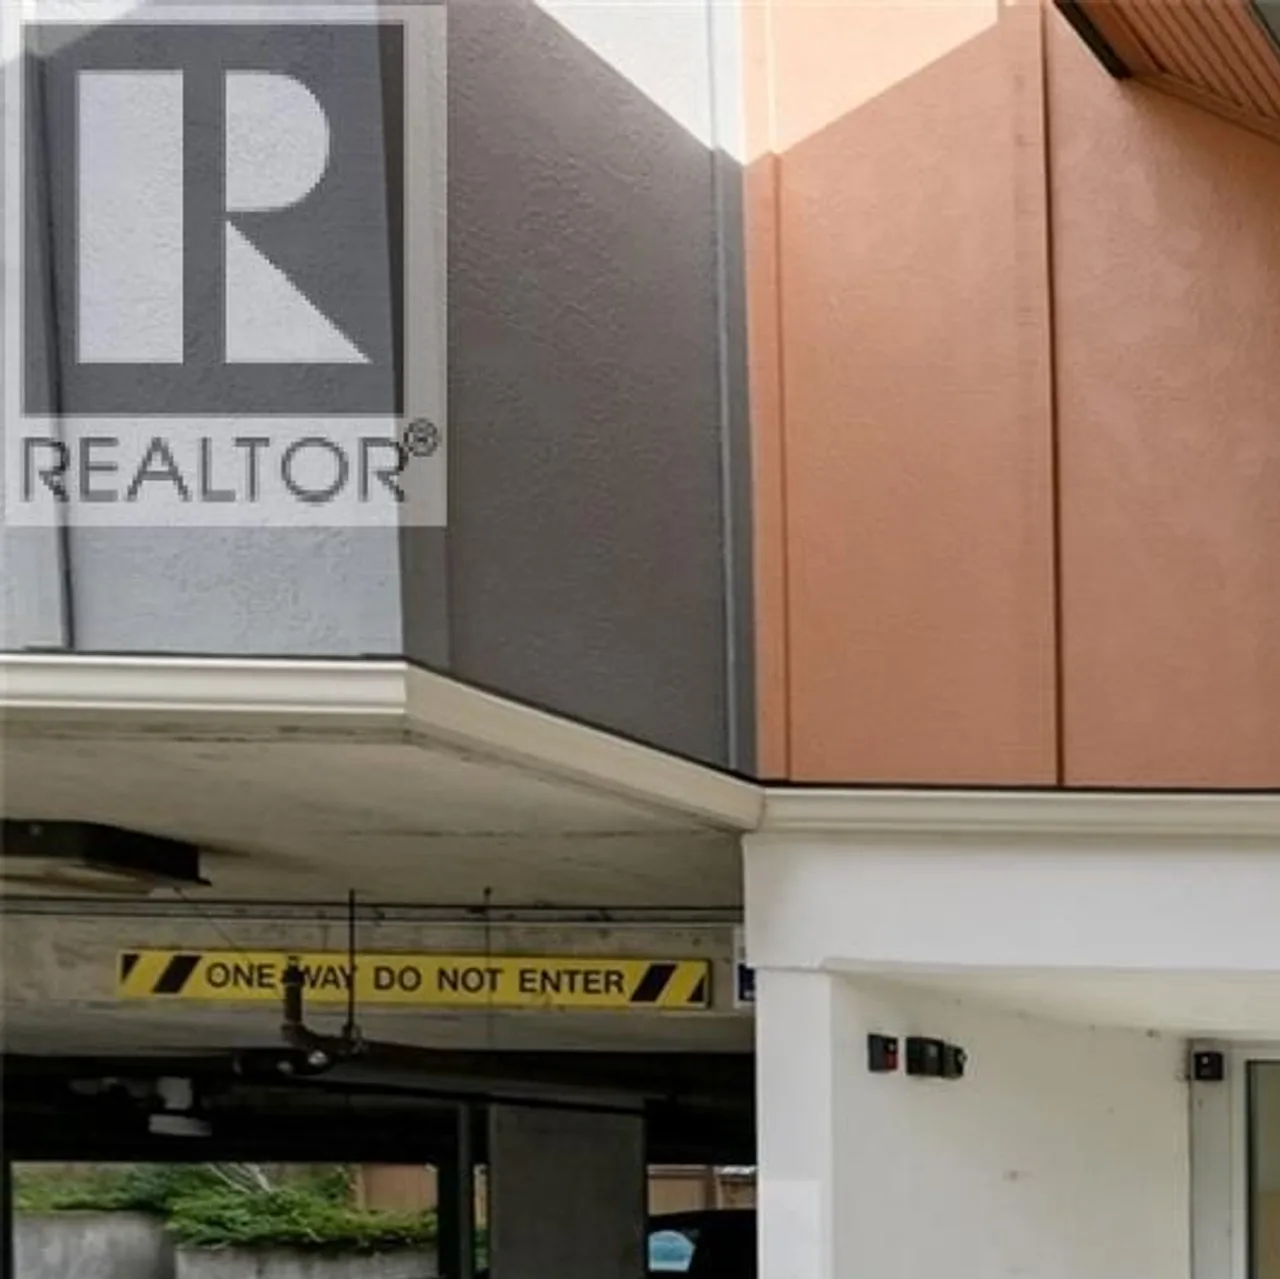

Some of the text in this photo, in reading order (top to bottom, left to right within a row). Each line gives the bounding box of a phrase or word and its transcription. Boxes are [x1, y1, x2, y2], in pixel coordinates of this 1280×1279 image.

[206, 962, 275, 989] ONE
[373, 965, 421, 991] DO
[438, 967, 503, 992] NOT
[519, 969, 624, 994] ENTER
